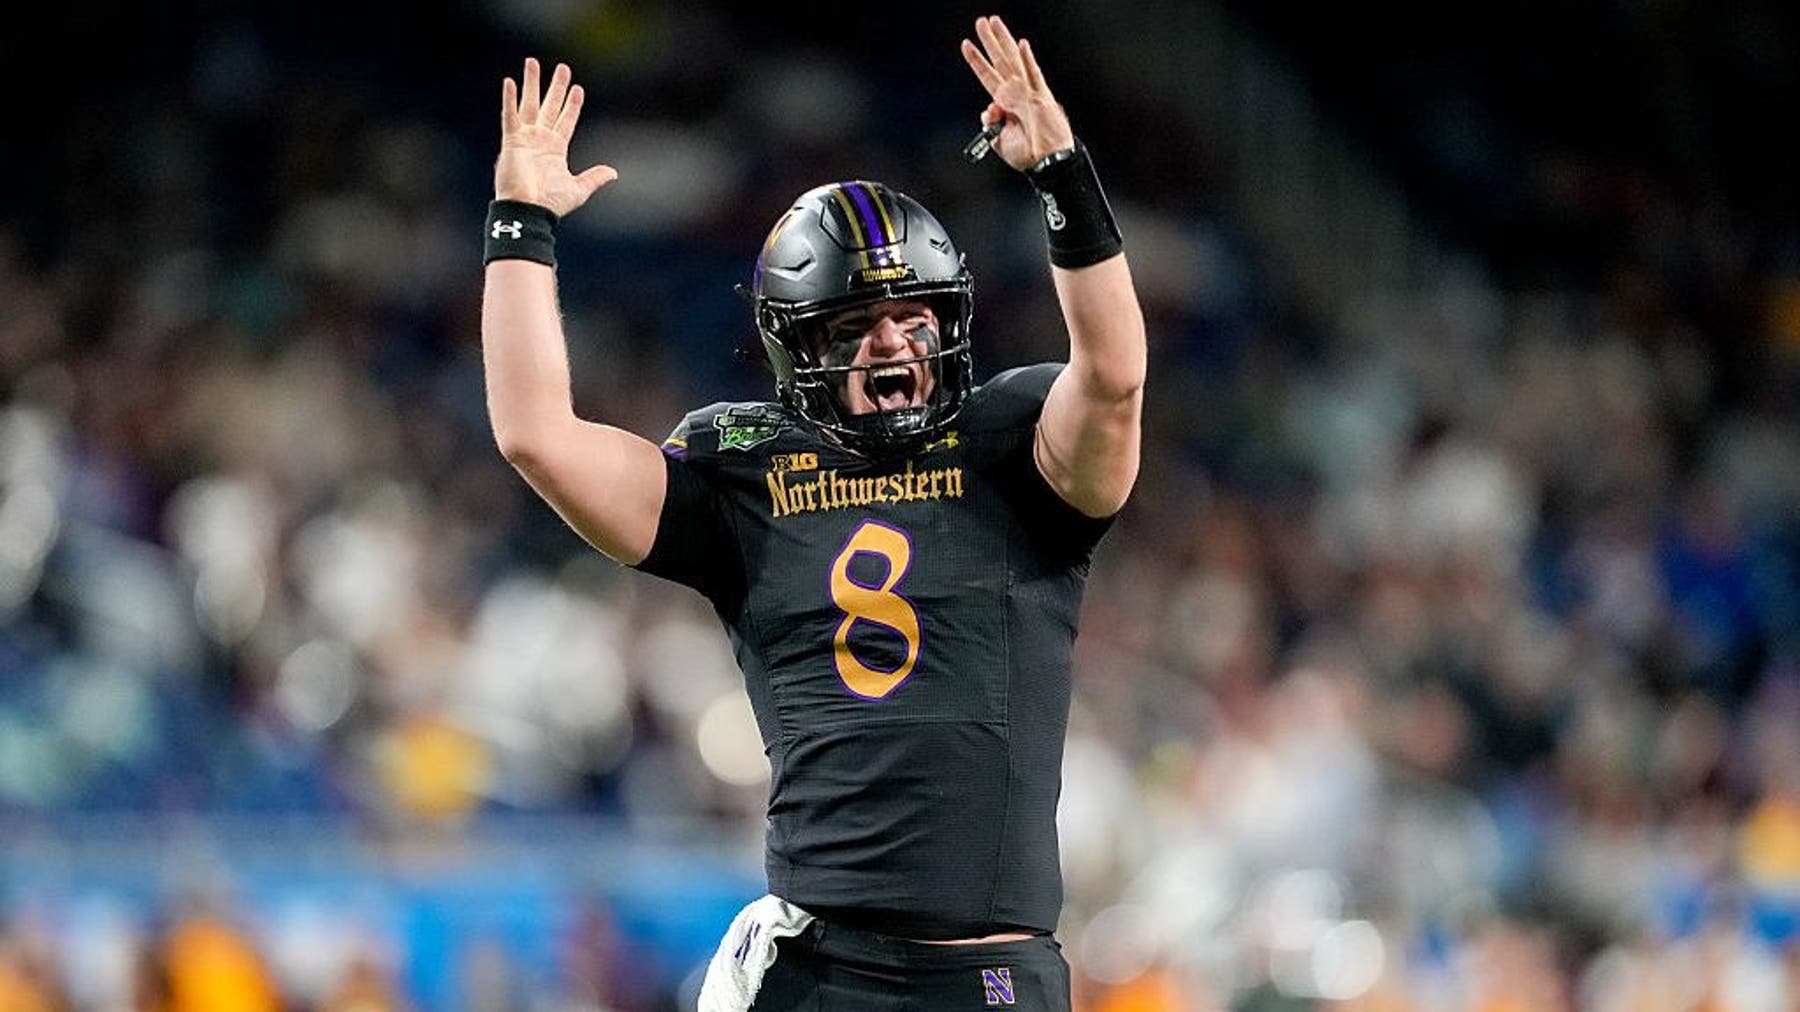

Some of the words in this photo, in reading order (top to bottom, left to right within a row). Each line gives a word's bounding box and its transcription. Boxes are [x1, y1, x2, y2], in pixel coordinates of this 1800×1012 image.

[766, 459, 964, 517] Northwestern
[827, 518, 922, 702] 8
[982, 968, 1015, 1004] N
